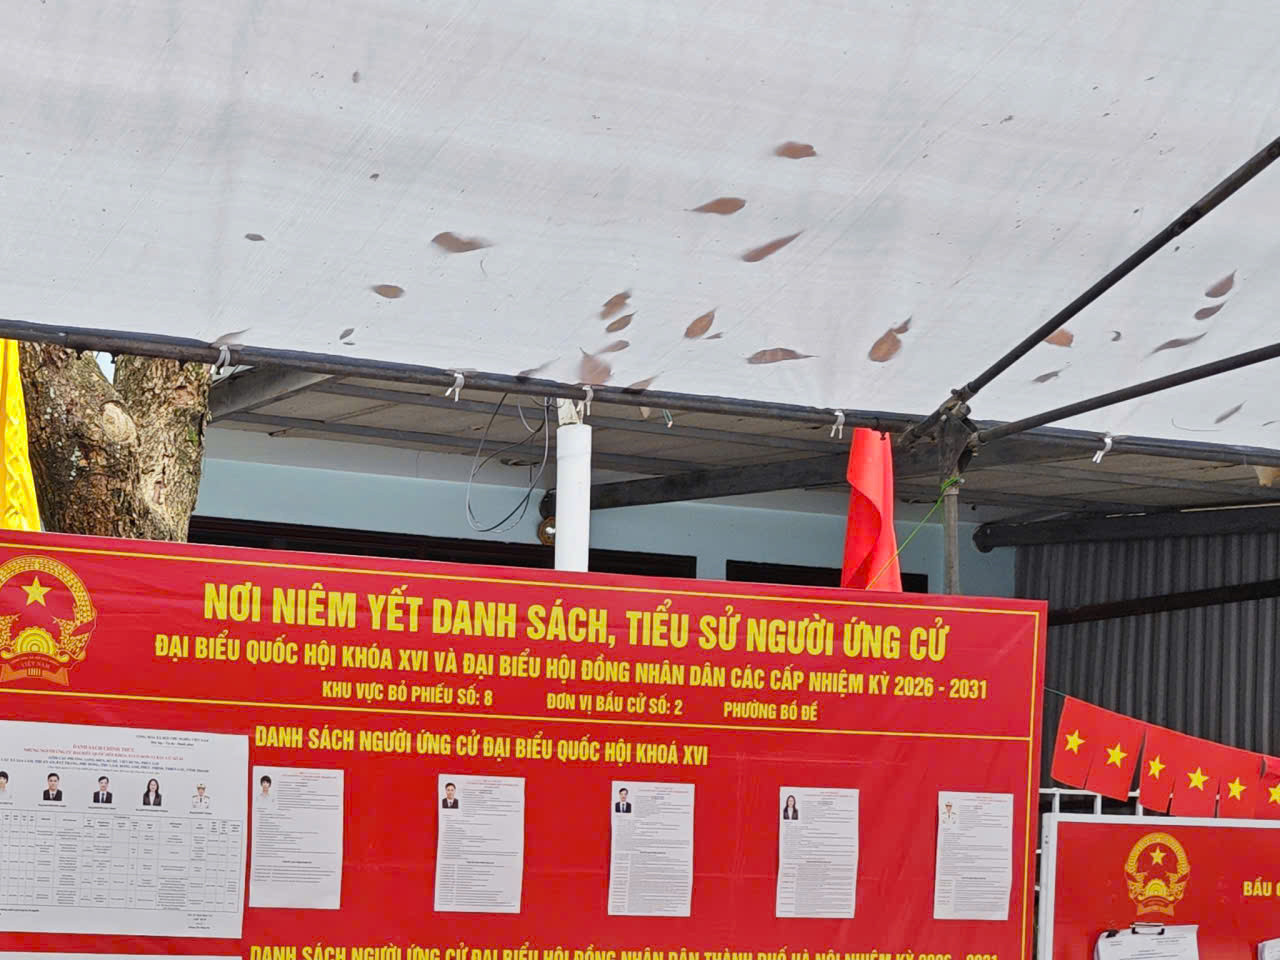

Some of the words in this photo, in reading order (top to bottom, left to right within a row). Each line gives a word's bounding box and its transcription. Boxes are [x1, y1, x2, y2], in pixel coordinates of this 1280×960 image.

[203, 582, 262, 622] NƠI
[271, 582, 357, 628] NIÊM
[367, 586, 424, 632] YẾT
[431, 598, 517, 638] DANH
[526, 599, 616, 645] SÁCH,
[625, 599, 690, 648] TIỂU
[697, 605, 741, 651] SỬ
[745, 613, 835, 656] NGƯỜI
[842, 616, 902, 659] ỨNG
[909, 617, 951, 661] CỬ
[154, 634, 189, 662] ĐẠI
[194, 629, 241, 661] BIỂU
[245, 634, 299, 664] QUỐC
[303, 640, 337, 670] HỘI
[341, 643, 393, 670] KHÓA
[398, 649, 429, 671] XVI
[433, 648, 458, 673] VÀ
[462, 653, 494, 678] ĐẠI
[498, 648, 541, 678] BIỂU
[545, 654, 576, 682] HỘI
[634, 660, 685, 685] NHÂN
[689, 662, 726, 687] DÂN
[730, 664, 766, 689] CÁC
[770, 664, 804, 690] CẤP
[808, 669, 864, 697] NHIỆM
[868, 671, 890, 695] KỲ
[894, 676, 935, 697] 2026
[949, 678, 987, 699] 2031
[322, 681, 351, 698] KHU
[355, 682, 384, 703] VỰC
[411, 683, 453, 704] PHIẾU
[483, 690, 493, 706] 8
[546, 692, 576, 710] ĐƠN
[579, 695, 593, 714] VỊ
[626, 693, 647, 713] CỬ
[674, 699, 683, 715] 2
[723, 699, 777, 719] PHƯỜNG
[254, 726, 304, 748] DANH
[307, 725, 355, 750] SÁCH
[359, 728, 412, 753] NGƯỜI
[415, 729, 452, 755] ỨNG
[455, 729, 480, 756] CỬ
[482, 736, 511, 761] ĐẠI
[514, 731, 553, 759] BIỂU
[556, 734, 601, 762] QUỐC
[604, 738, 632, 766] HỘI
[682, 745, 709, 765] XVI
